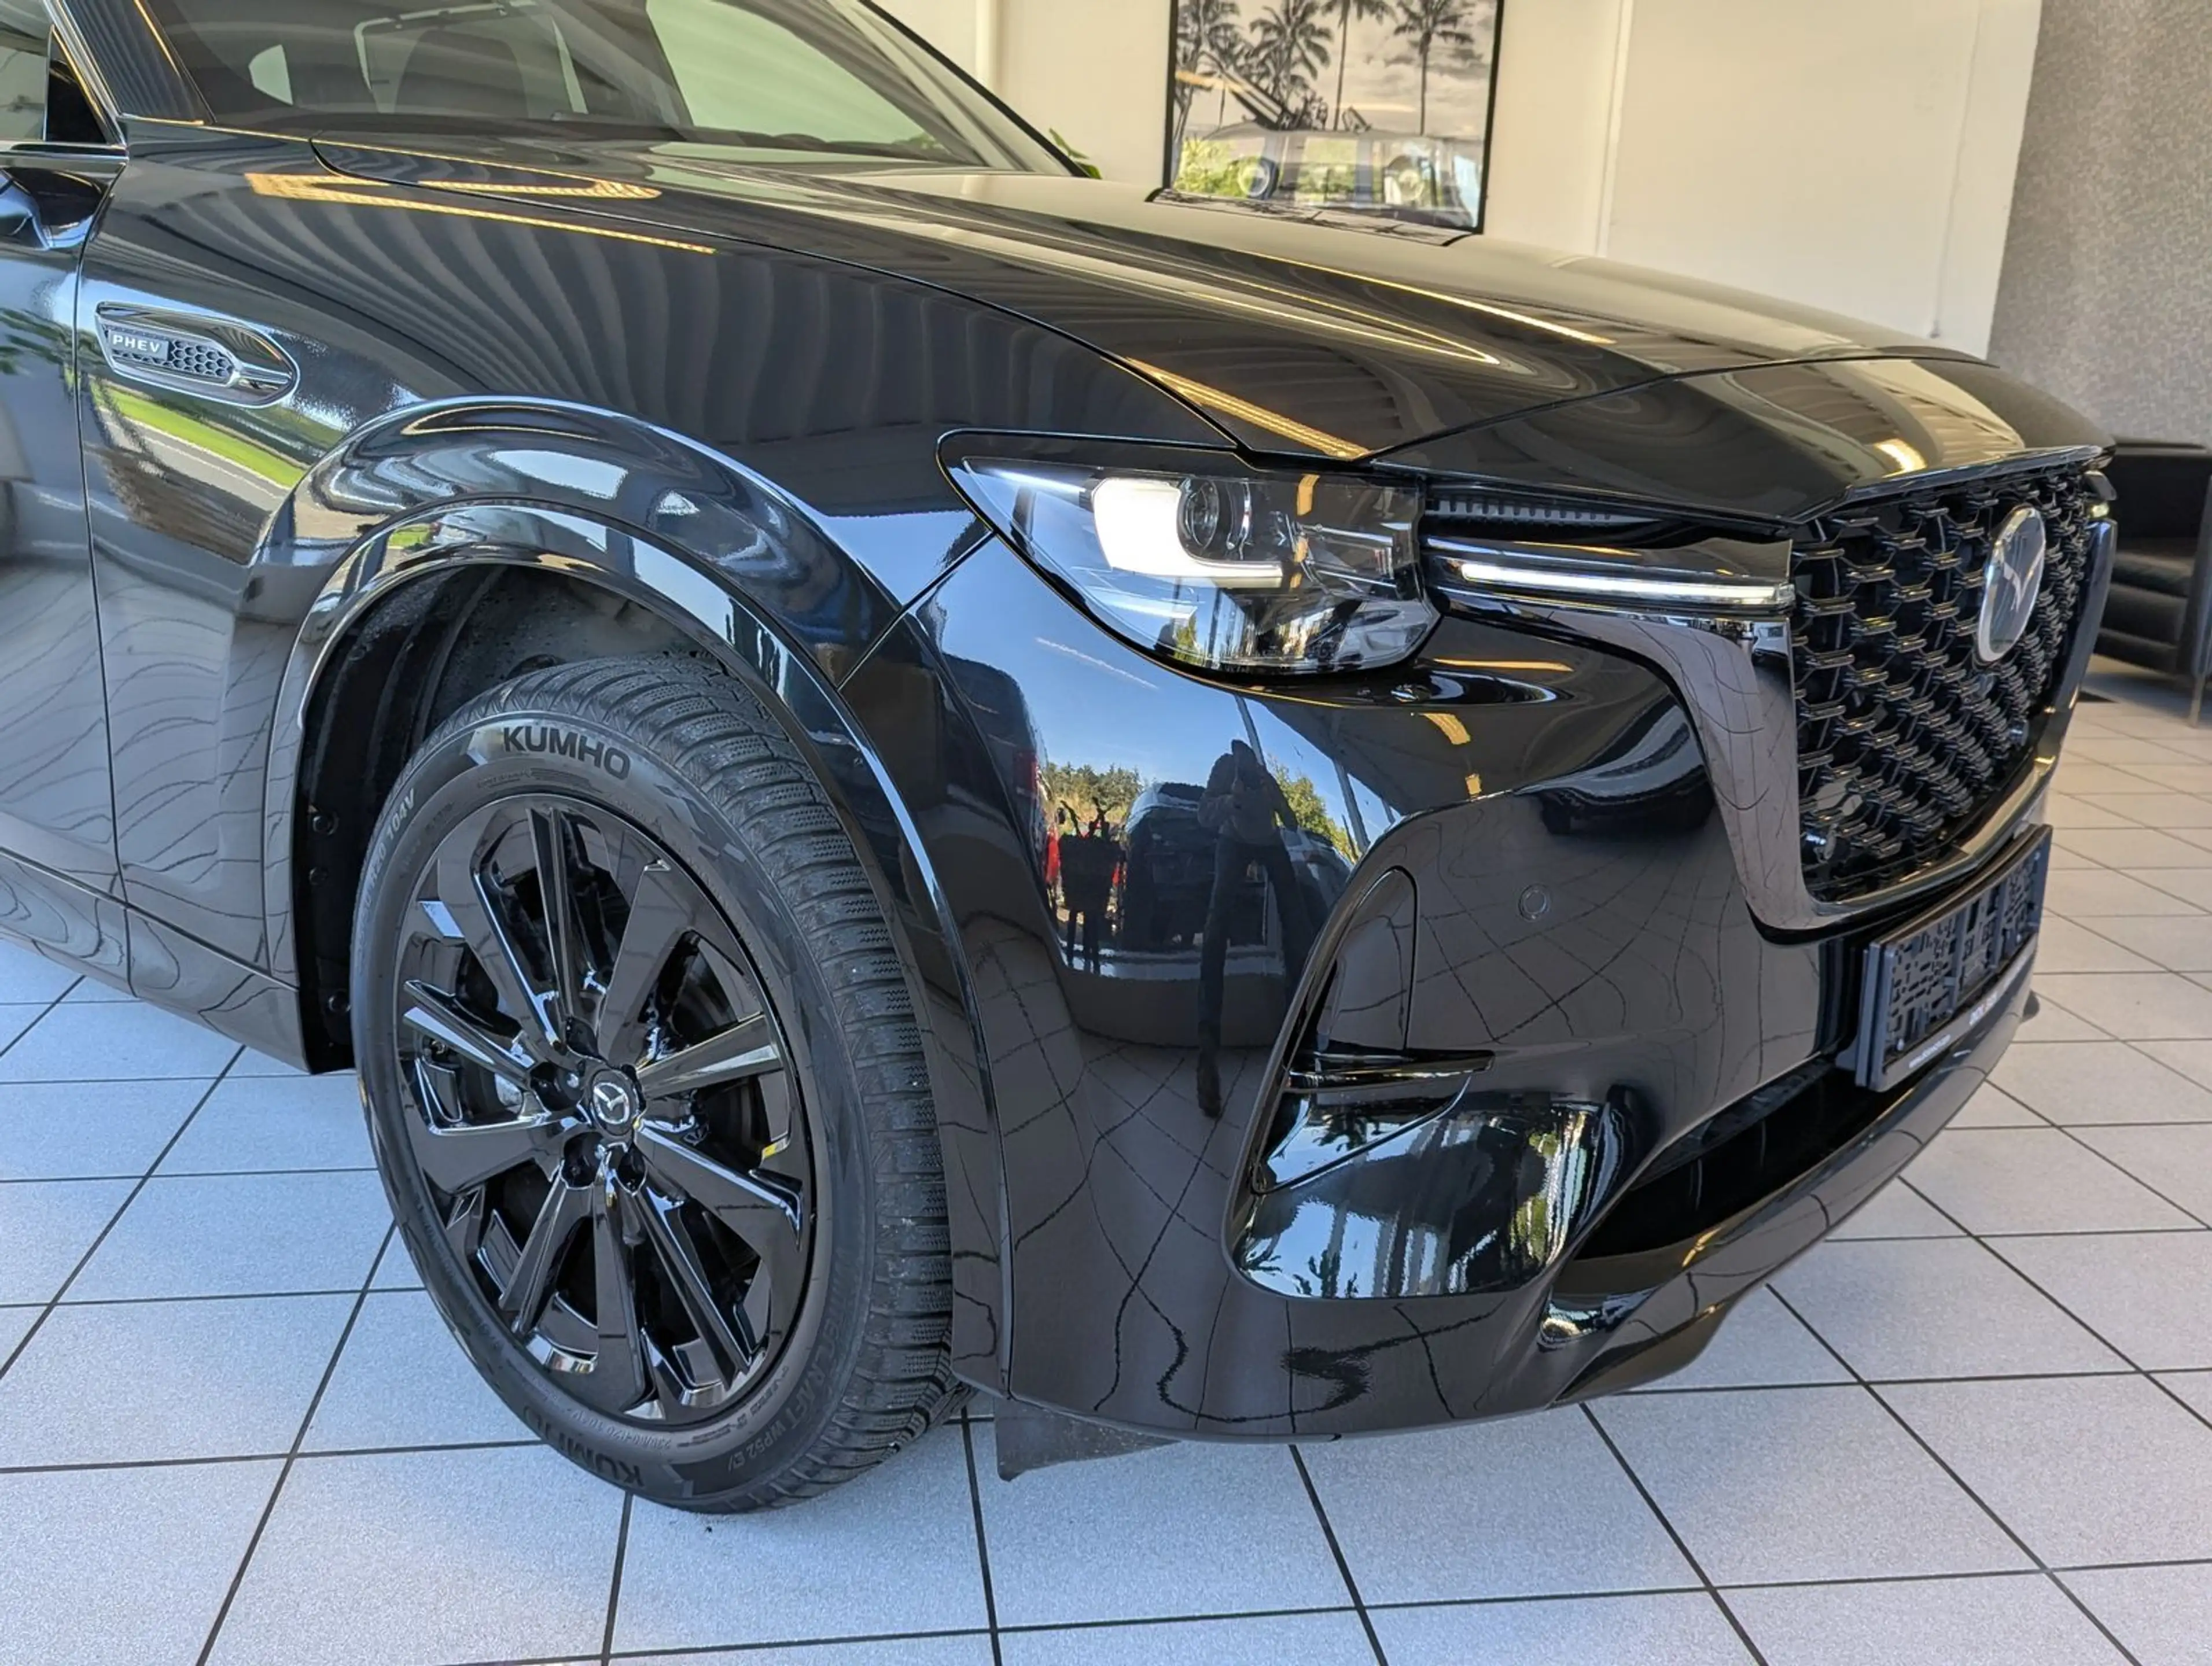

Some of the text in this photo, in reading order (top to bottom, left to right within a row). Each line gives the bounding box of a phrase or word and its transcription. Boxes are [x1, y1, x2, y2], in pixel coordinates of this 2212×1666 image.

[113, 334, 160, 352] PHEV
[503, 725, 631, 780] KUMHO
[746, 1420, 786, 1459] WP52
